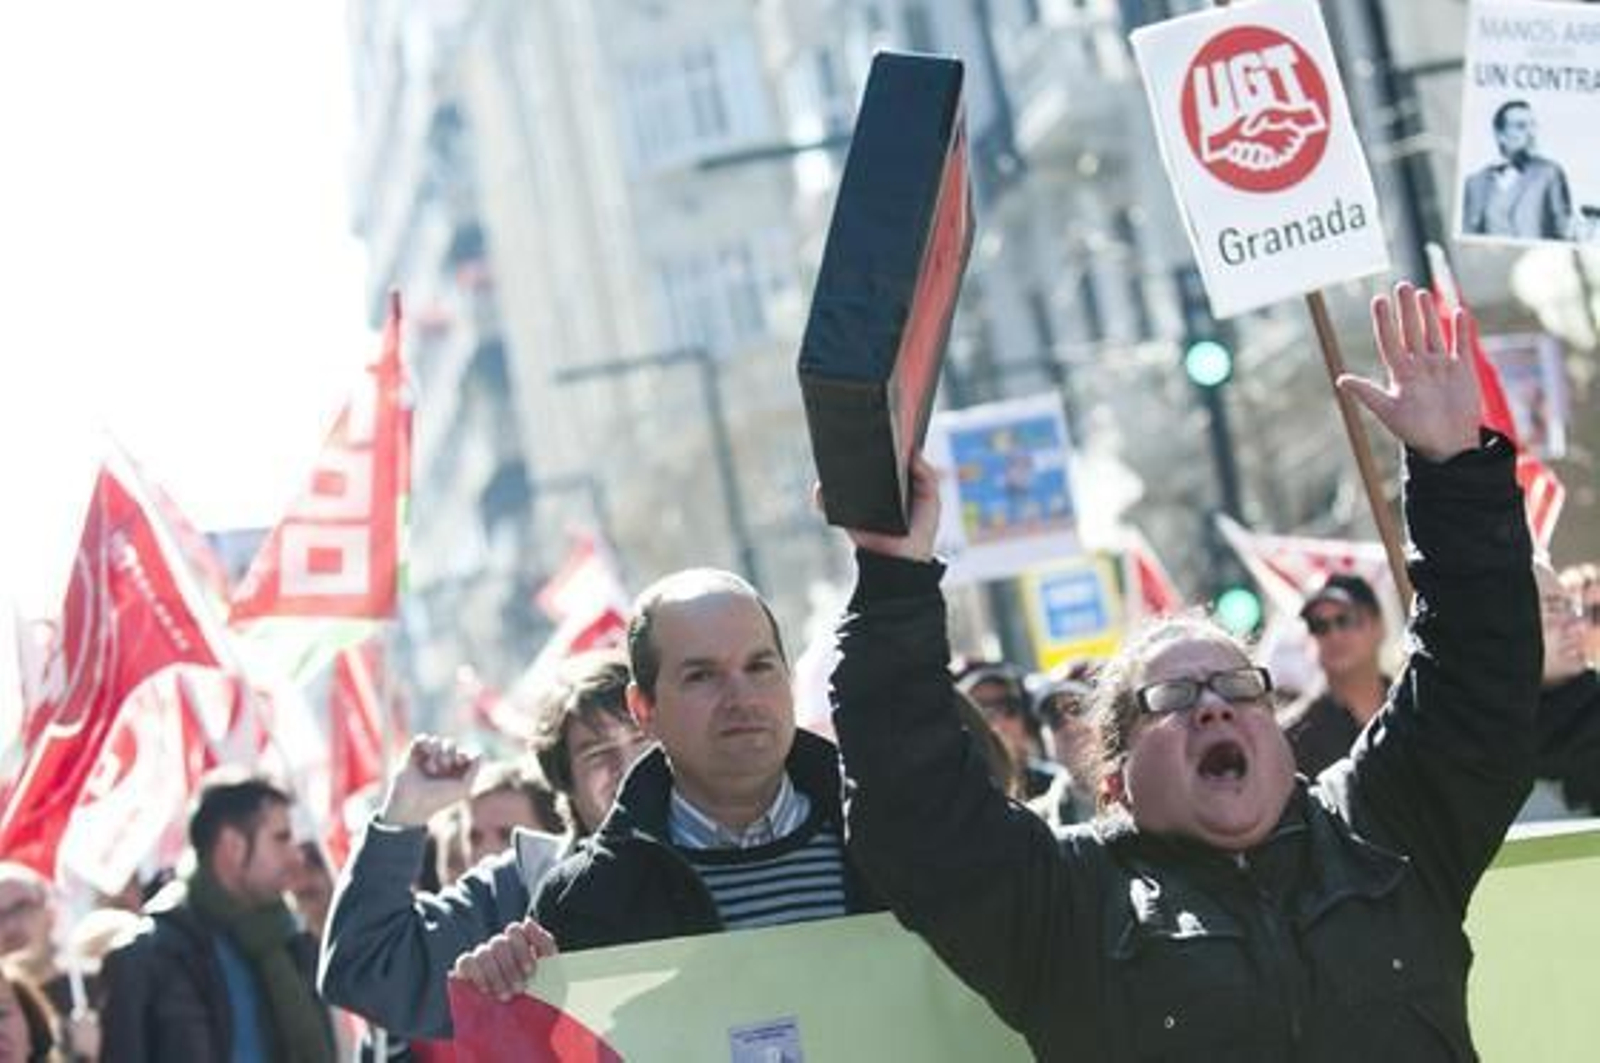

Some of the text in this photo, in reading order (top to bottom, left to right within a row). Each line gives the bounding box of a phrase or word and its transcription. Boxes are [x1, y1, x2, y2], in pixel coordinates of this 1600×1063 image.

[1480, 15, 1557, 43] MANOS
[1194, 43, 1300, 134] UGT
[1474, 62, 1507, 88] UN
[1218, 198, 1366, 266] Granada
